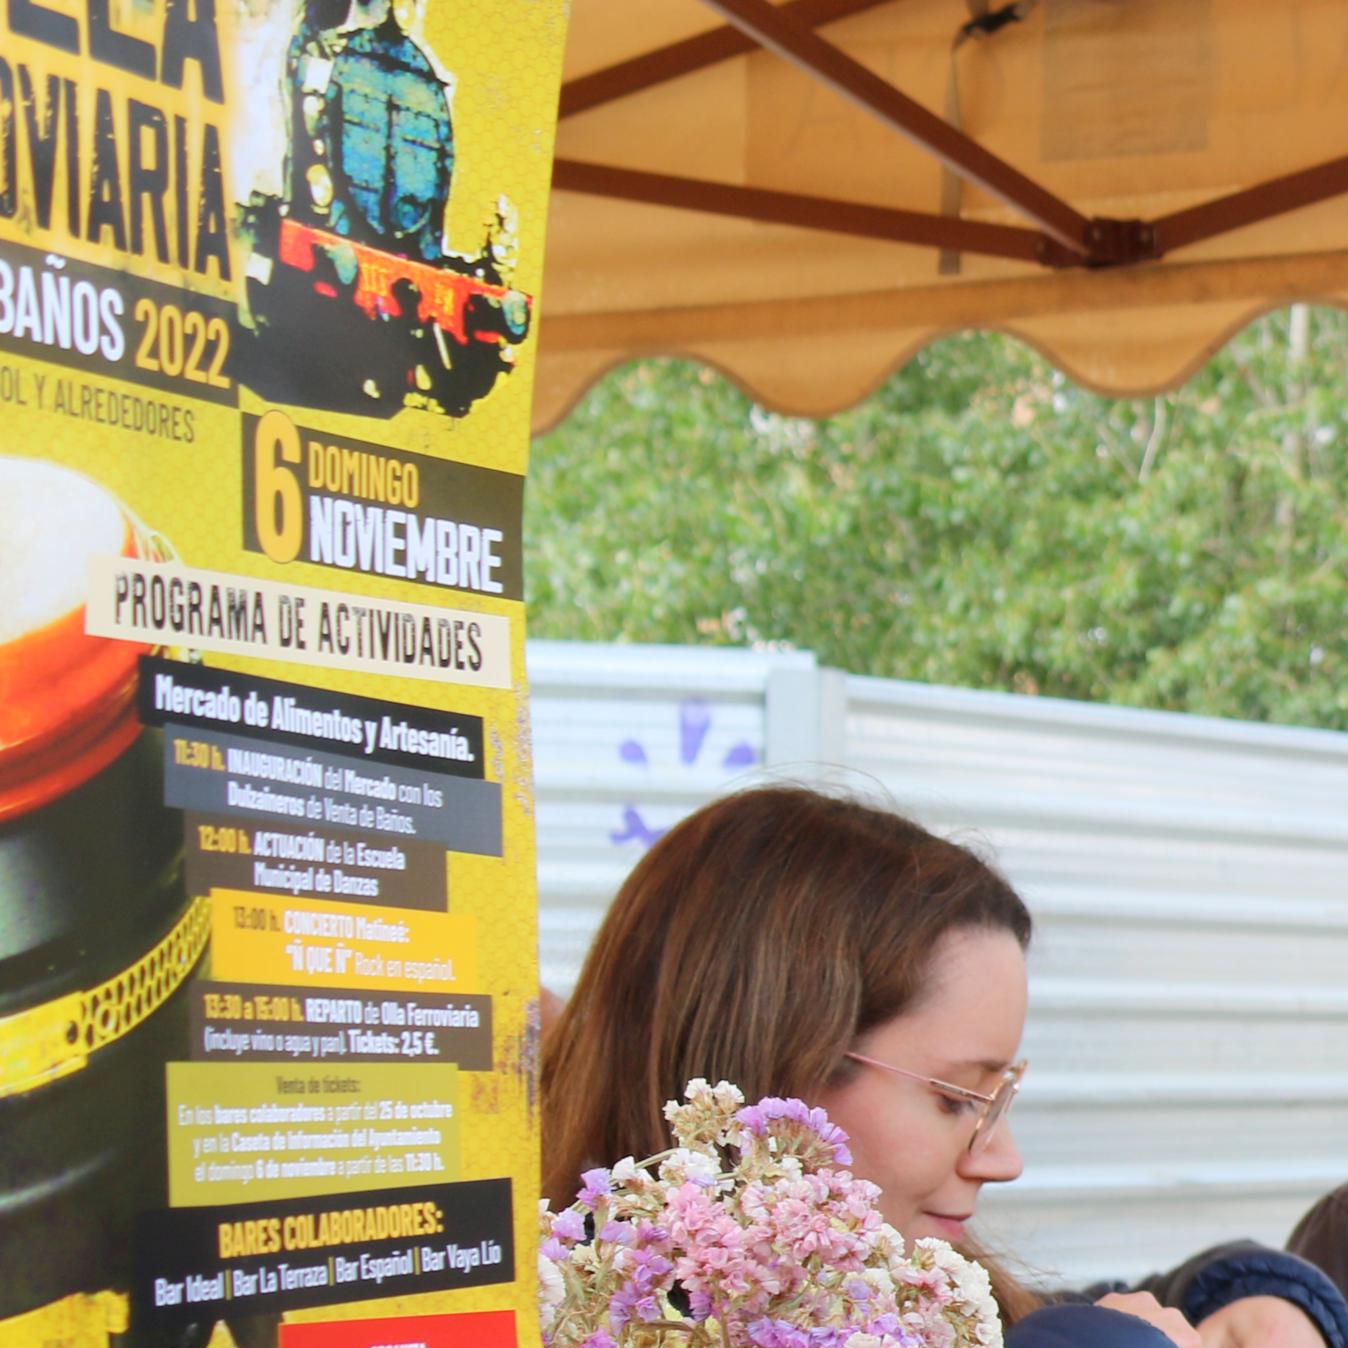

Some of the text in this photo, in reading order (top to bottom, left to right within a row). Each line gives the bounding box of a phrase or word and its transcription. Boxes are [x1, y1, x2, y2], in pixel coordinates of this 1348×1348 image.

[135, 298, 231, 389] 2022
[33, 372, 47, 409] Y
[54, 379, 196, 444] ALREDEDORES
[255, 410, 302, 564] 6
[308, 441, 420, 508] DOMINGO
[309, 495, 504, 594] NOVIEMBRE
[115, 572, 484, 672] PROGRAMA DE ACTIVIDADES
[155, 673, 476, 762] Mercado de Alimentos y Artesanía.
[227, 747, 324, 789] INAUGURACIÓN
[324, 766, 343, 791] del
[344, 768, 397, 801] Mercado
[398, 783, 421, 805] con
[423, 782, 443, 808] los
[227, 780, 417, 834] Dulzaineros de Venta de Baños.
[198, 824, 237, 854] 12:00
[253, 831, 326, 862] ACTUACIÓN
[326, 840, 342, 864] de
[343, 840, 355, 865] la
[356, 842, 407, 871] Escuela
[254, 861, 379, 897] Municipal de Danzas
[284, 910, 353, 940] CONCIERTO
[306, 946, 333, 975] QUE
[353, 951, 384, 978] Rock
[386, 959, 402, 979] en
[305, 997, 362, 1025] REPARTO
[364, 1001, 380, 1025] de
[381, 1001, 405, 1026] Olla
[406, 1002, 480, 1028] Ferroviaria
[348, 1028, 400, 1054] Tickets:
[401, 1031, 423, 1057] 2,5
[410, 1100, 452, 1119] octubre
[231, 1131, 271, 1152] Caseta
[368, 1126, 441, 1152] Ayuntamiento
[218, 1201, 445, 1259] BARES COLABORADORES:
[154, 1239, 502, 1307] Bar Ideal Bar La Terraza Bar Español Bar Vaya Lío
